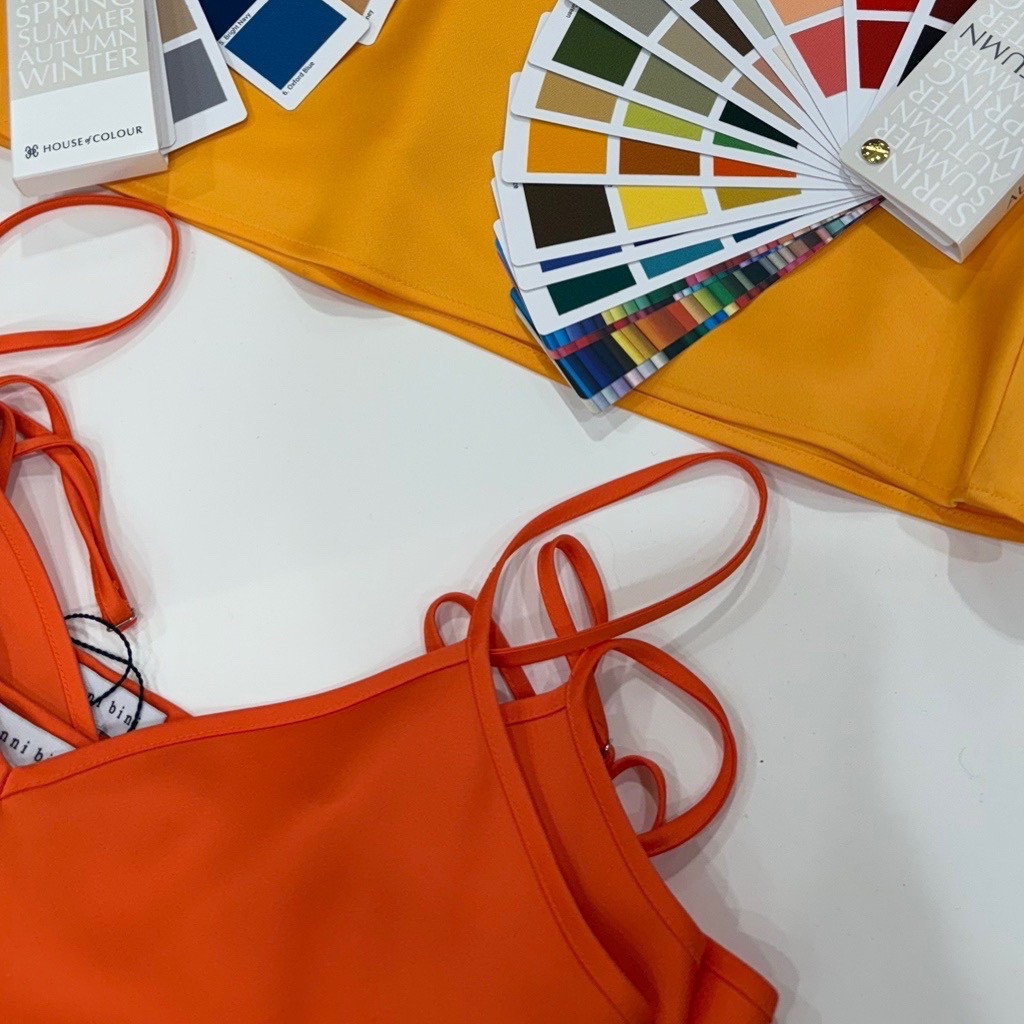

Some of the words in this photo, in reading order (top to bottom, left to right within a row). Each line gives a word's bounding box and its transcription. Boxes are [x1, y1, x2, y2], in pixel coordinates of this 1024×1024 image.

[18, 7, 134, 48] SUMMER
[224, 24, 240, 40] Bright
[237, 13, 251, 25] Navy
[17, 27, 137, 68] AUTUMN
[18, 46, 138, 89] WINTER
[287, 72, 304, 90] Oxford
[302, 62, 315, 73] Blue
[43, 136, 83, 153] HOUSE
[92, 125, 142, 143] COLOUR
[889, 97, 1012, 188] AUTUMN
[853, 134, 978, 230] SPRIN
[871, 115, 996, 208] SUMMER
